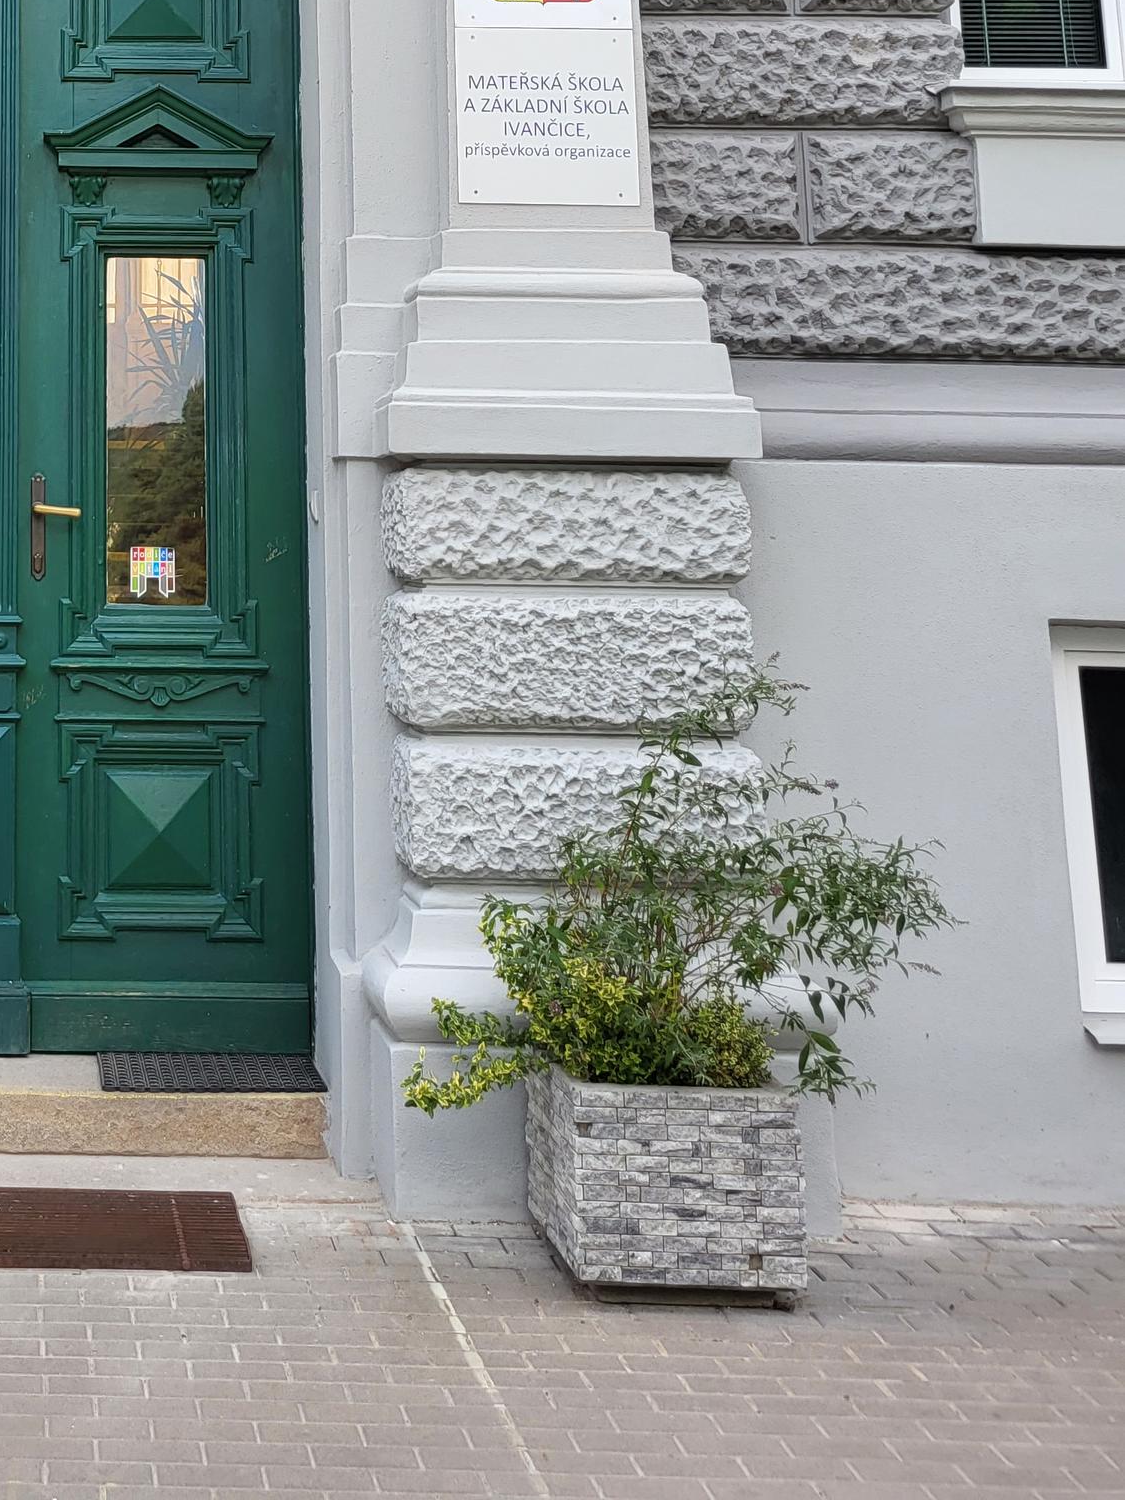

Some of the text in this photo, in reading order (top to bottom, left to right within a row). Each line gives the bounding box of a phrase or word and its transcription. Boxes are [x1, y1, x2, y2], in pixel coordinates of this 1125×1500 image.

[468, 71, 624, 92] MATEŘSKÁ ŠKOLA
[463, 94, 630, 116] A ZÁKLADNÍ ŠKOLA
[504, 118, 591, 140] IVANČICE,
[465, 142, 631, 160] příspěvková organizace
[132, 549, 173, 559] rodiče
